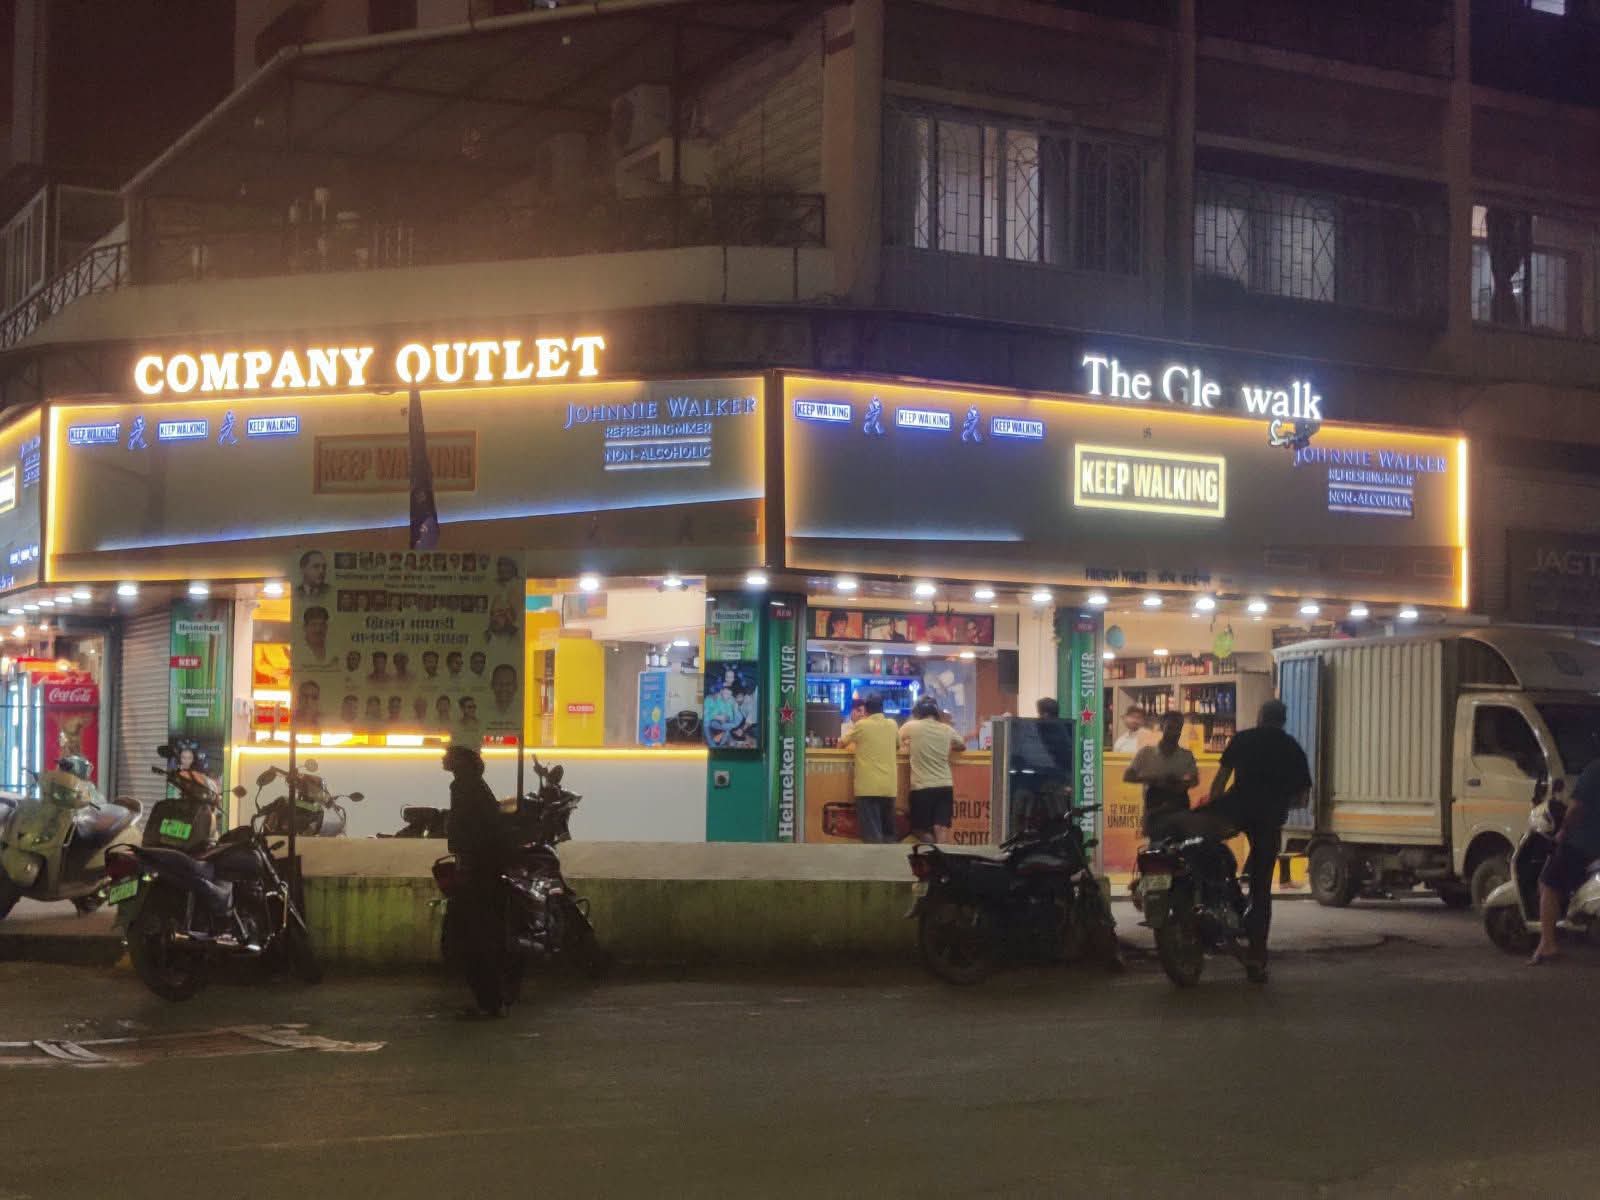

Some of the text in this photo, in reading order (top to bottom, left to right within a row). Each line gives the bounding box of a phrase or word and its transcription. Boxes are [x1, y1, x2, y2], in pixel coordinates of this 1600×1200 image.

[133, 335, 606, 395] COMPANY OUTLET
[1082, 354, 1153, 400] The
[1241, 379, 1323, 421] walk
[249, 417, 296, 432] KEEP WALKING
[563, 395, 757, 431] JOHNNIE WALKER
[796, 401, 849, 419] KEEP WALKING
[898, 408, 949, 428] KEEP WALKING
[70, 426, 116, 442] KEEP WALKING
[160, 421, 206, 436] KEEP WALKING
[675, 422, 712, 436] MIXER
[993, 419, 1042, 436] KEEP WALKING
[374, 446, 473, 480] WAING
[1377, 449, 1447, 474] WALKER
[1081, 459, 1219, 504] KEEP WALKING
[781, 645, 796, 694] SILVER
[1081, 652, 1095, 698] SILVER
[778, 736, 796, 838] Heineken
